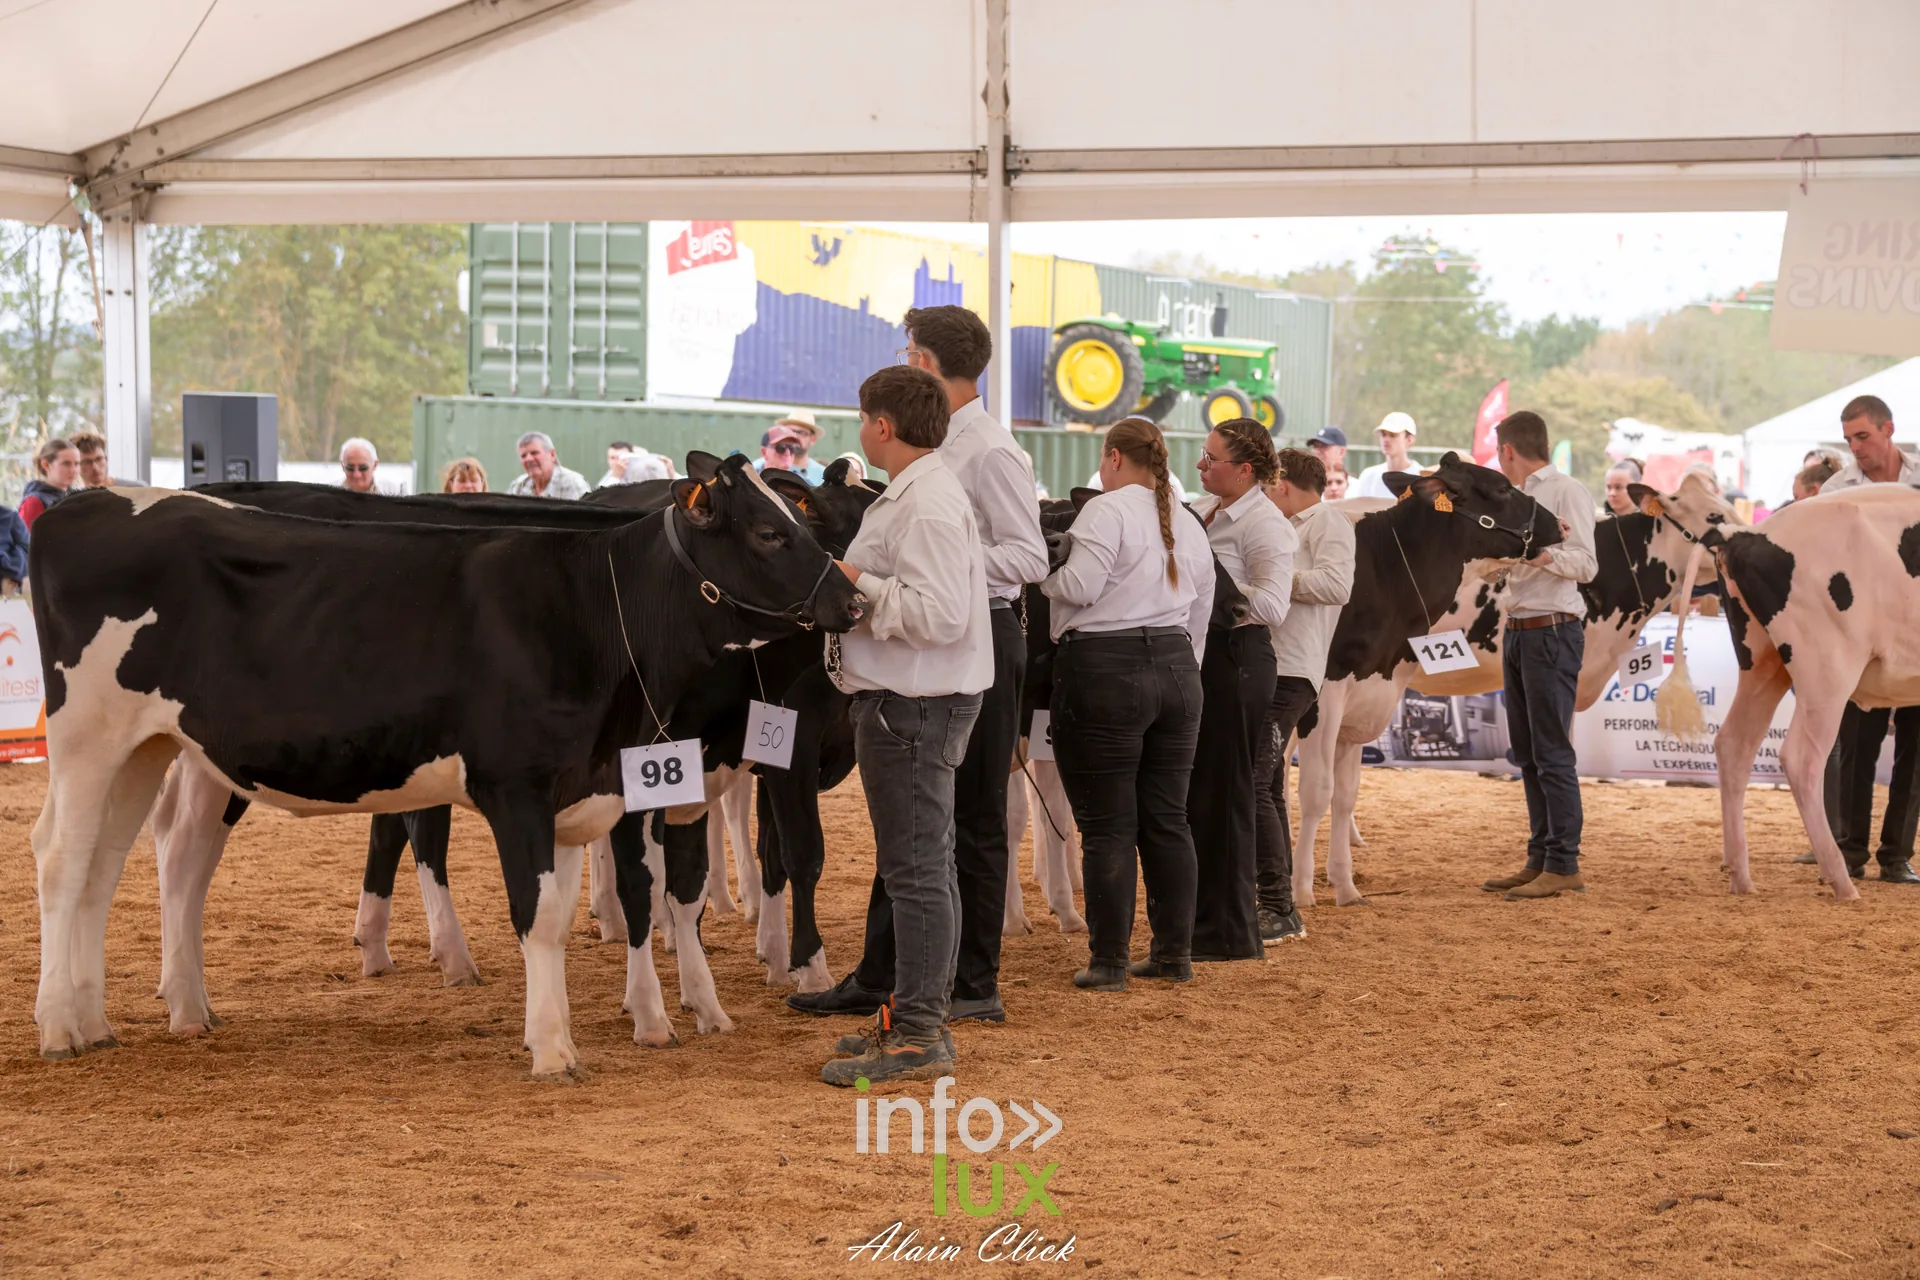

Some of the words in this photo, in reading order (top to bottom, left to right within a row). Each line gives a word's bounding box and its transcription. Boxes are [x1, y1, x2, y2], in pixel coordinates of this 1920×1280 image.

[1421, 640, 1465, 662] 121
[1628, 654, 1652, 675] 95
[1633, 682, 1716, 706] Deal
[758, 721, 784, 749] 50
[1635, 740, 1651, 751] LA
[1653, 740, 1715, 754] TECHNQU
[641, 757, 683, 788] 98
[1653, 758, 1718, 771] L'EXPÉRIEN
